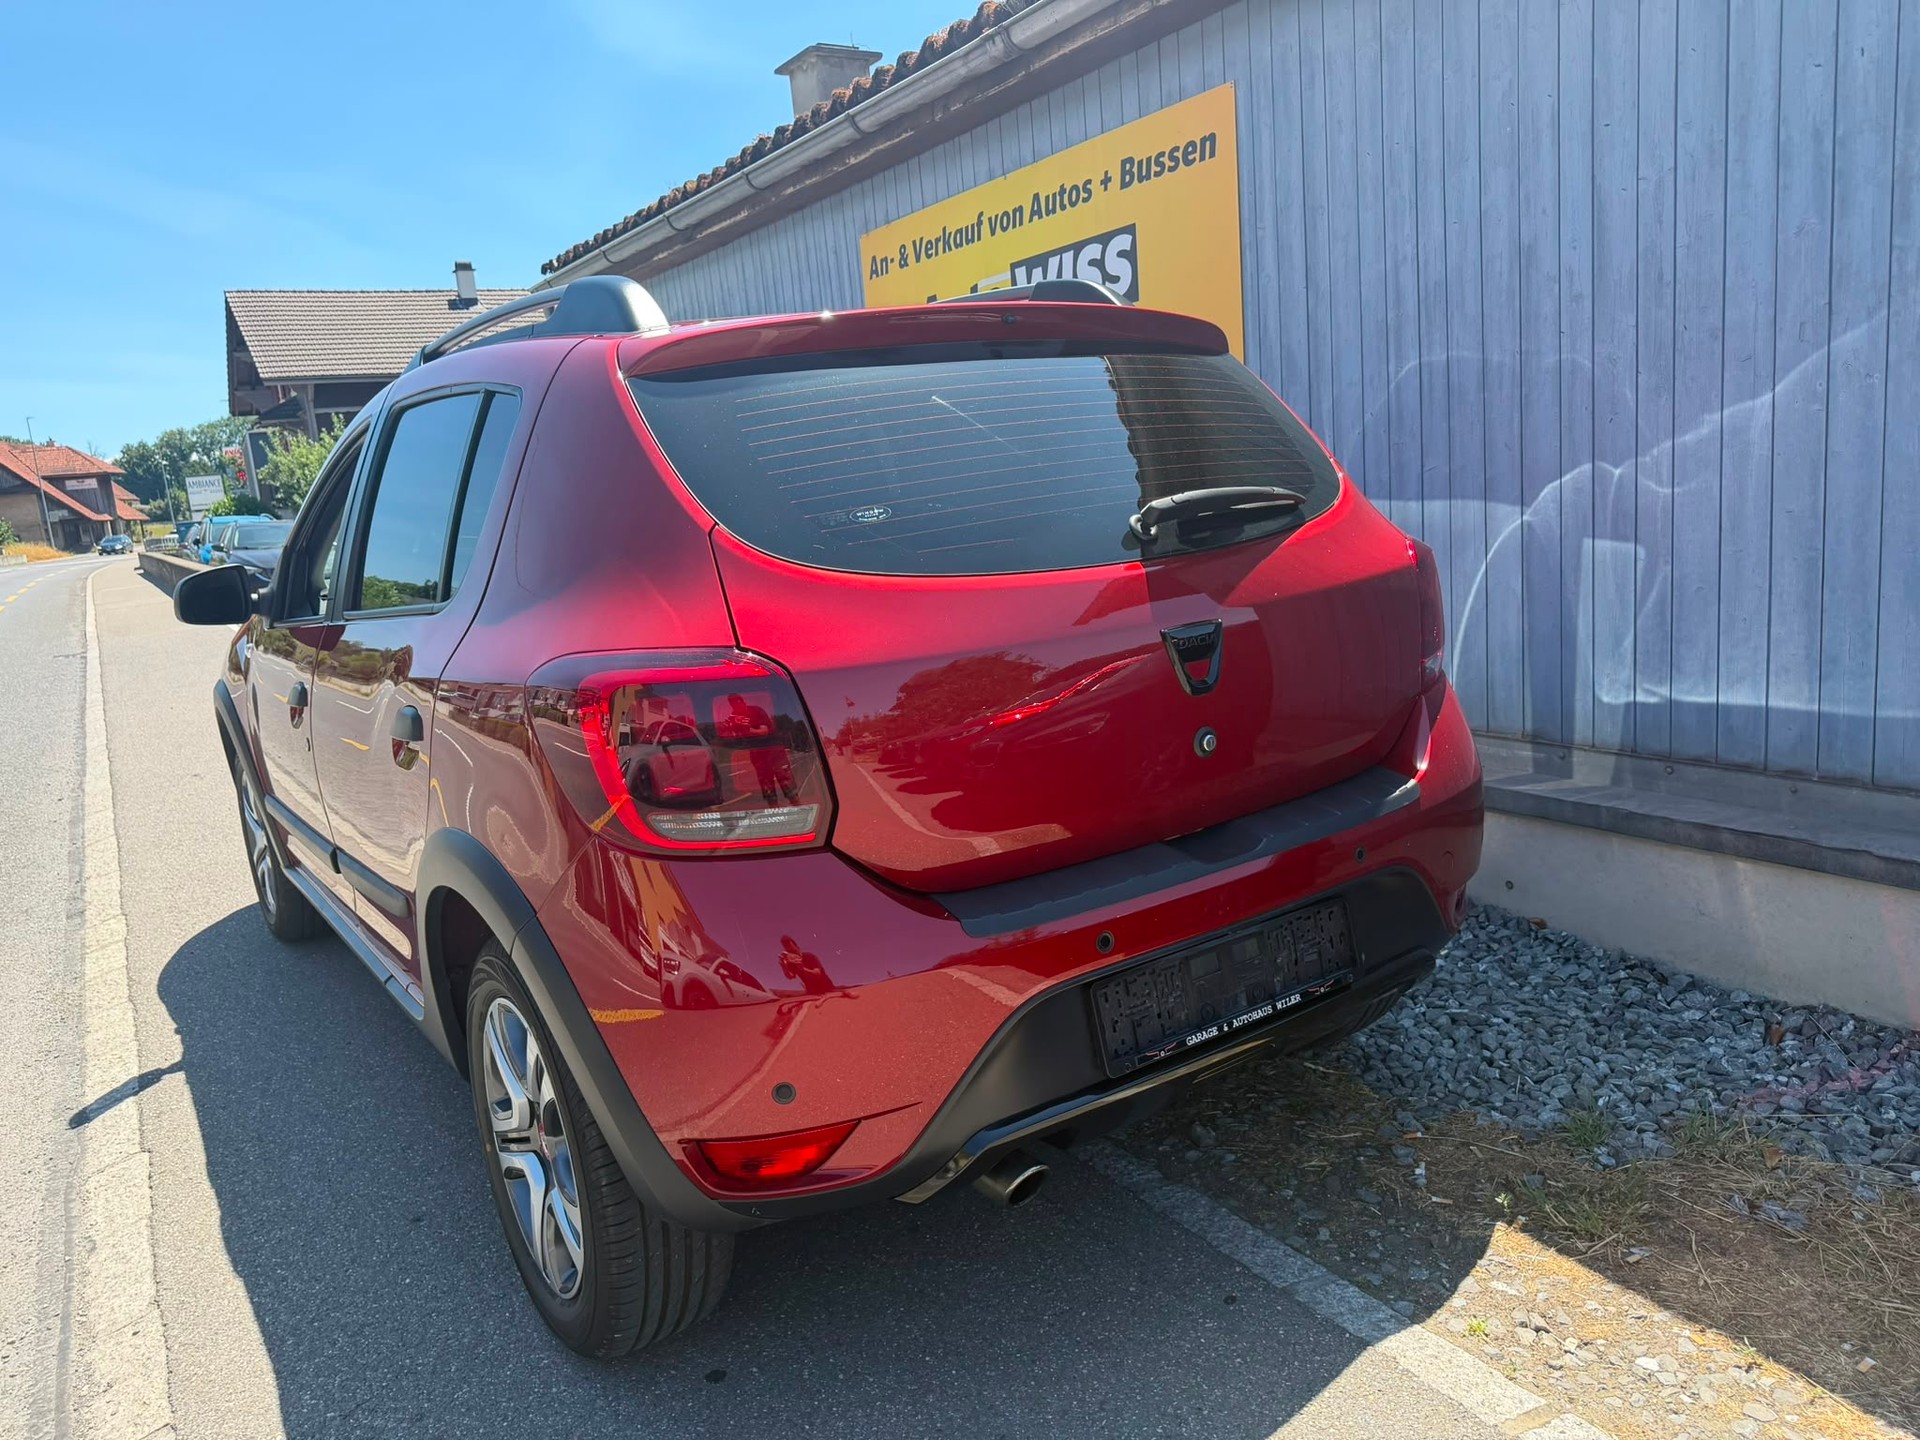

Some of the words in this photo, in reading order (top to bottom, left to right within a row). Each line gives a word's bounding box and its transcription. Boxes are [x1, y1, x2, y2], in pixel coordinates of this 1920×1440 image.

[869, 254, 895, 280] An-
[898, 244, 909, 270] &
[911, 210, 985, 265] Verkauf
[987, 203, 1024, 238] von
[1028, 179, 1093, 223] Autos
[1100, 170, 1112, 192] +
[1119, 131, 1217, 191] Bussen
[188, 479, 221, 489] AMBIANCE
[1185, 1026, 1219, 1046] GARAGE
[1223, 1023, 1229, 1032] &
[1232, 1005, 1273, 1028] AUTOHAUS
[1276, 993, 1302, 1011] WILER
